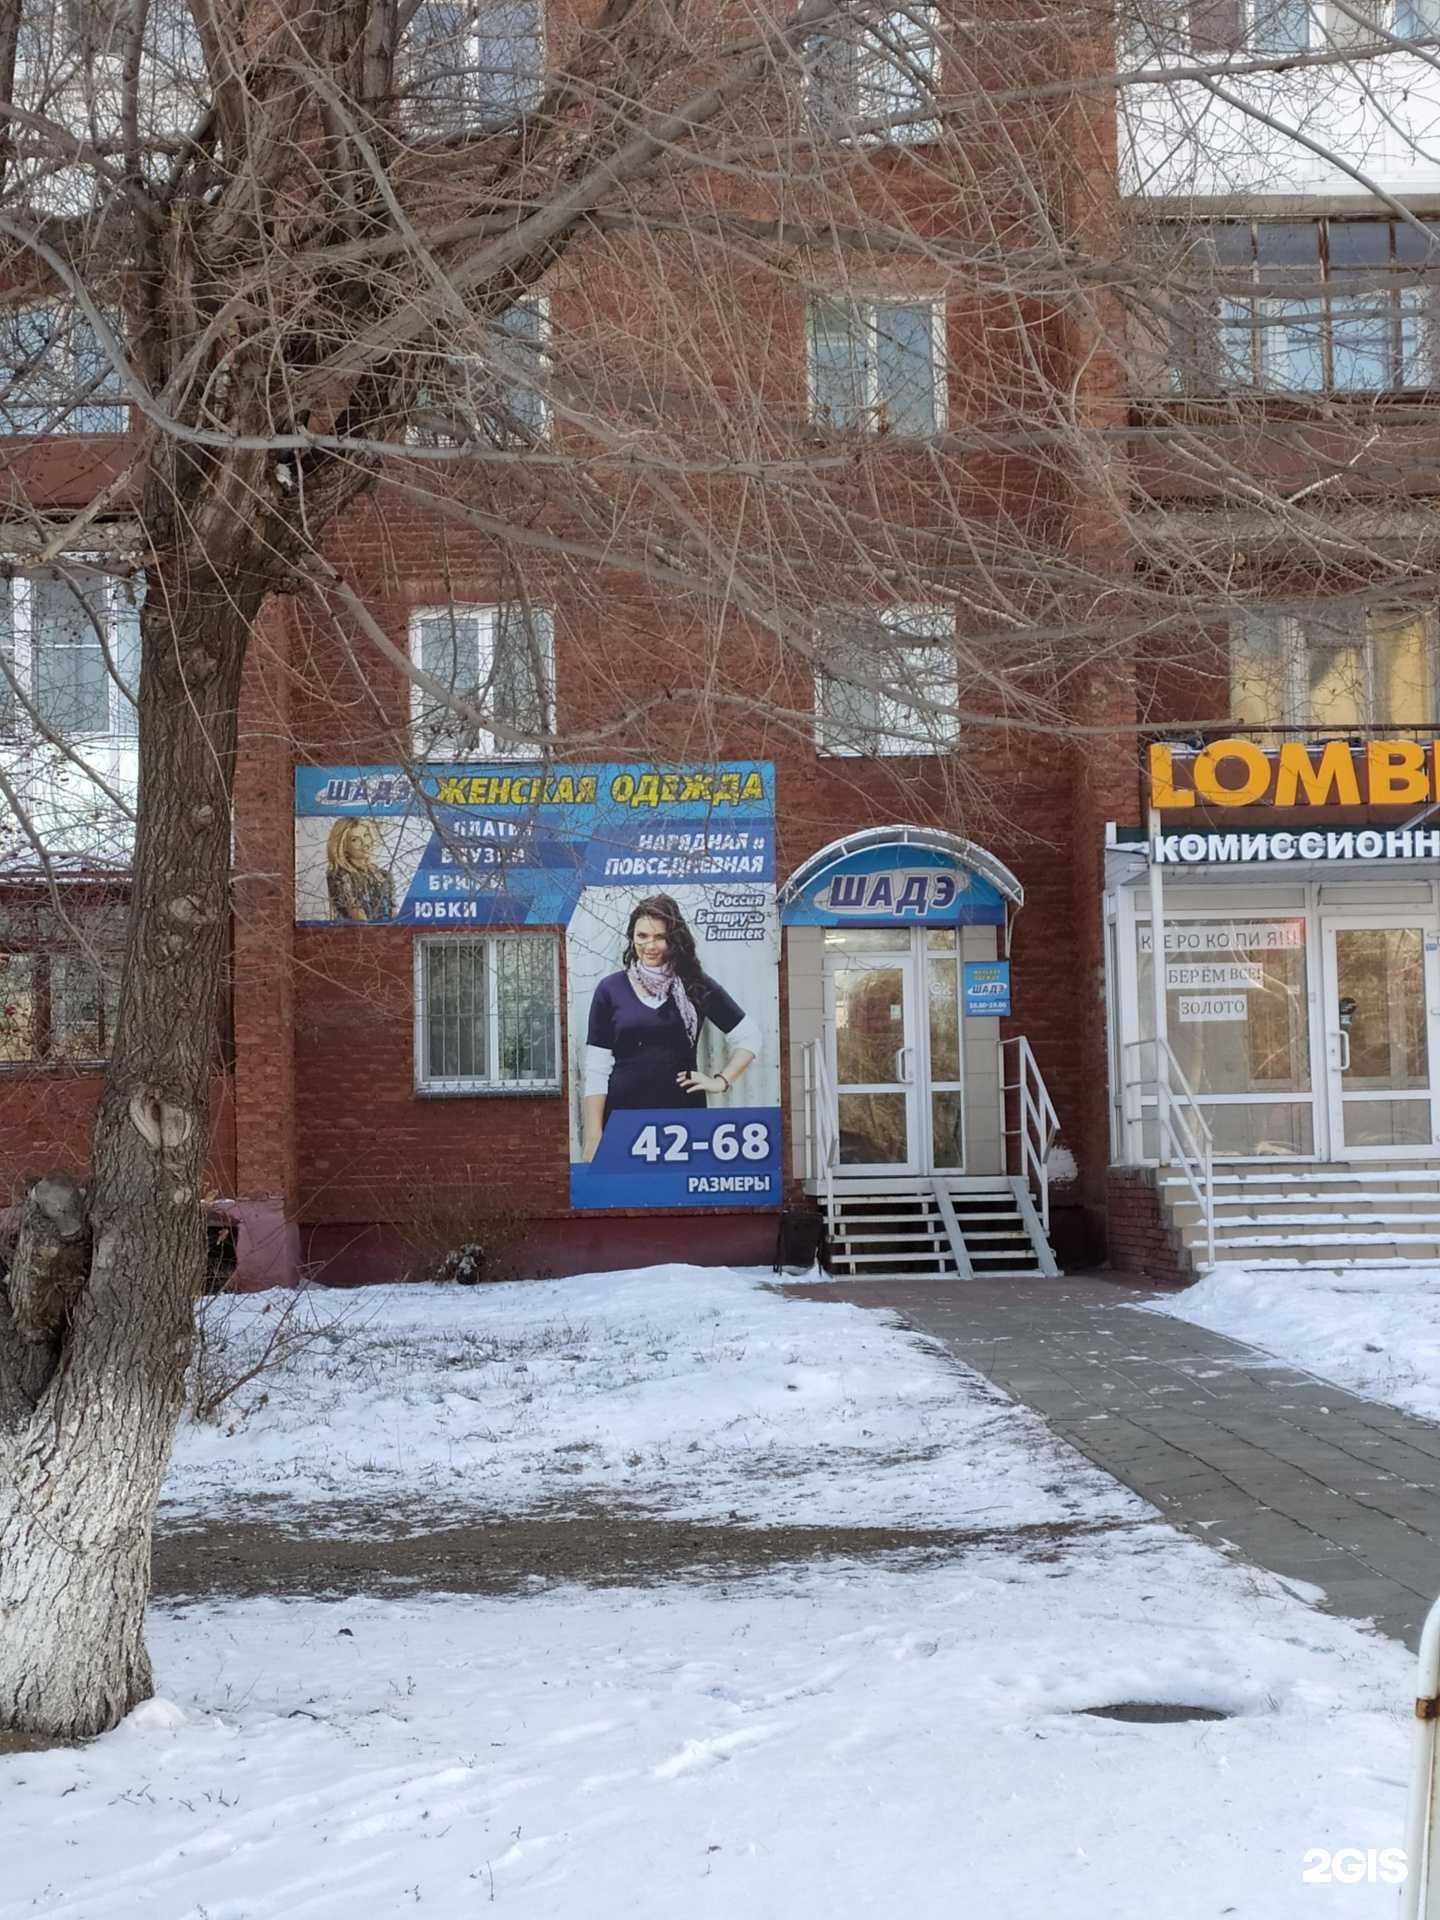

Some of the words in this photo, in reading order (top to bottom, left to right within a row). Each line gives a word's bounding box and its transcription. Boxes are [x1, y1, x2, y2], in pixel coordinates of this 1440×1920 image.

[1150, 739, 1440, 807] LOMB
[436, 776, 598, 804] ЖЕНСКАЯ
[610, 773, 763, 807] ОДЕЖДА
[638, 833, 749, 853] НАРЯДНАЯ
[1155, 830, 1440, 863] КОМИССИОНН
[604, 855, 764, 878] ПОВСЕДНЕВНАЯ
[714, 892, 766, 907] Россия
[828, 873, 957, 916] ШАДЭ
[415, 901, 477, 918] ЮБКИ
[696, 910, 765, 927] Беларусь
[706, 926, 766, 941] Бишкек
[1141, 931, 1298, 950] КЕРОКОПИЯ!!!
[1168, 967, 1226, 984] БЕРЁМ
[1181, 1000, 1245, 1015] ЗОЛОТО
[631, 1122, 770, 1162] 42-68
[687, 1176, 770, 1193] РАЗМЕРЫ
